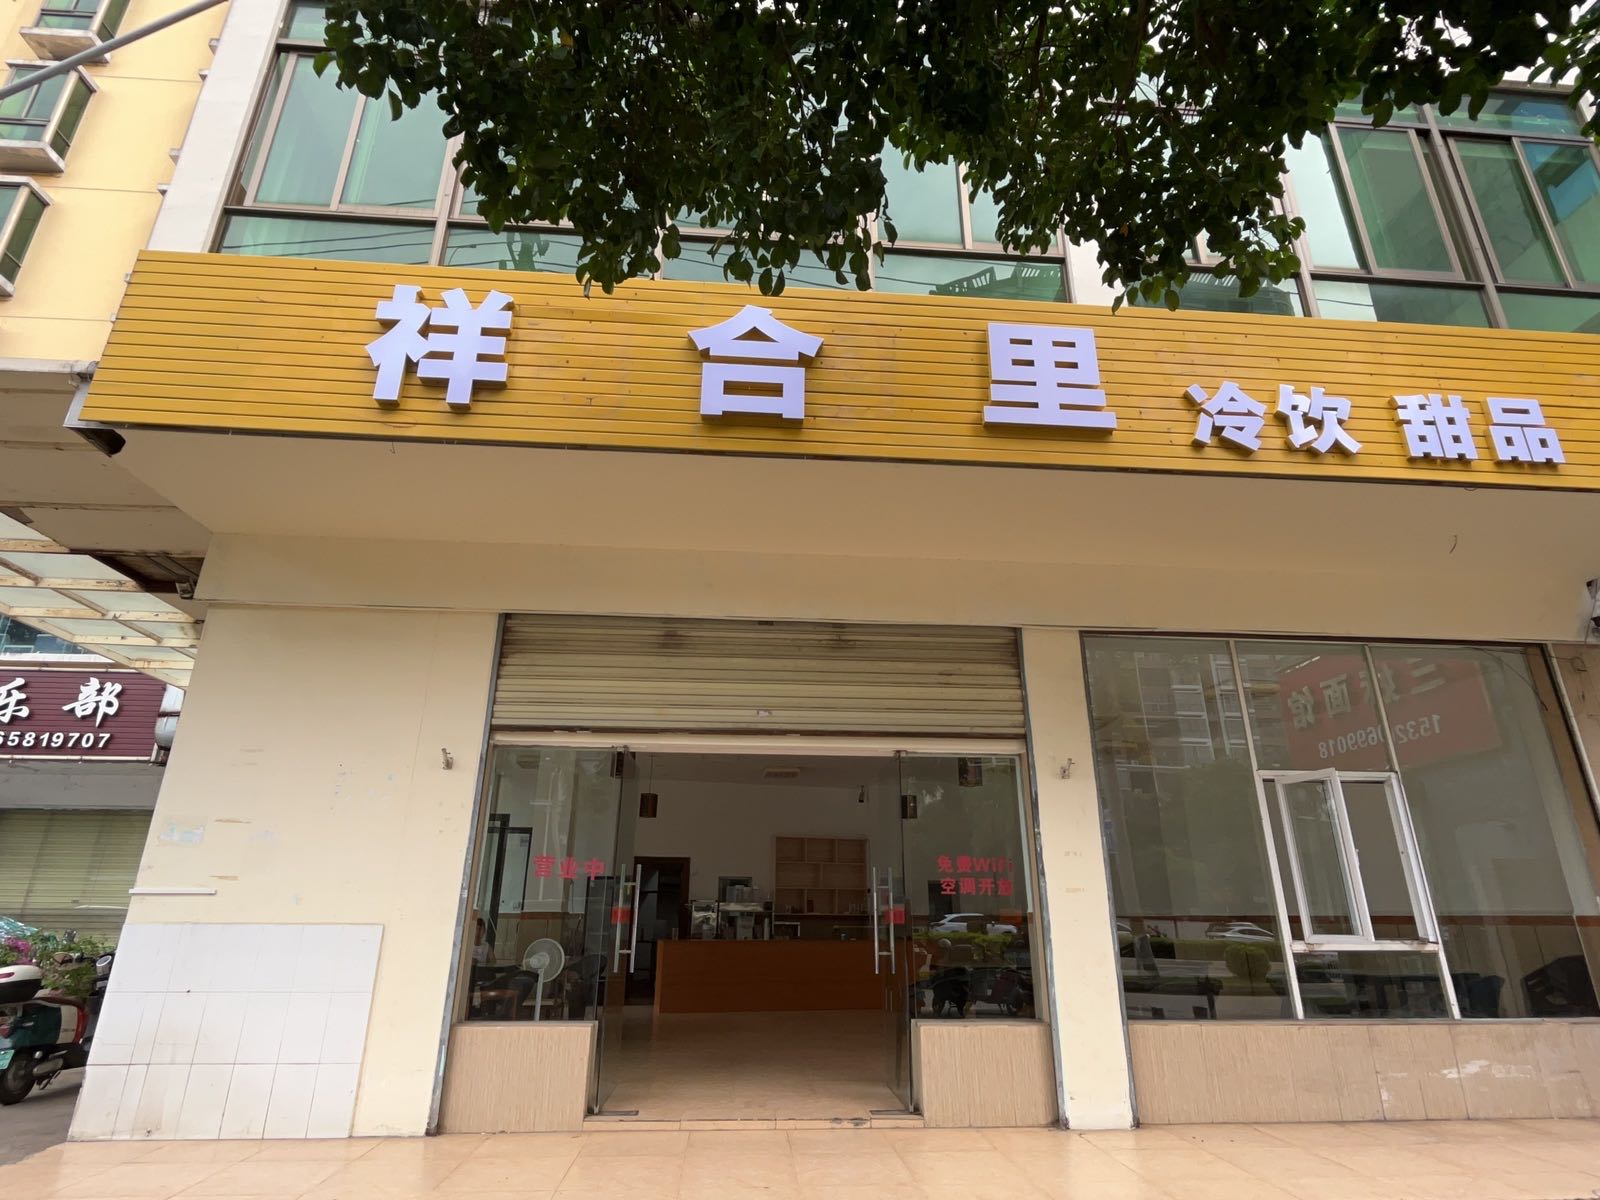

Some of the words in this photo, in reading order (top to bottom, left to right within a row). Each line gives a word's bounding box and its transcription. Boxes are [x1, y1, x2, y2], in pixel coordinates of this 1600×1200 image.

[365, 284, 1117, 431] 祥合里
[1183, 381, 1566, 465] 冷饮甜品
[532, 854, 606, 881] 营业中
[940, 877, 1014, 896] 空调开放
